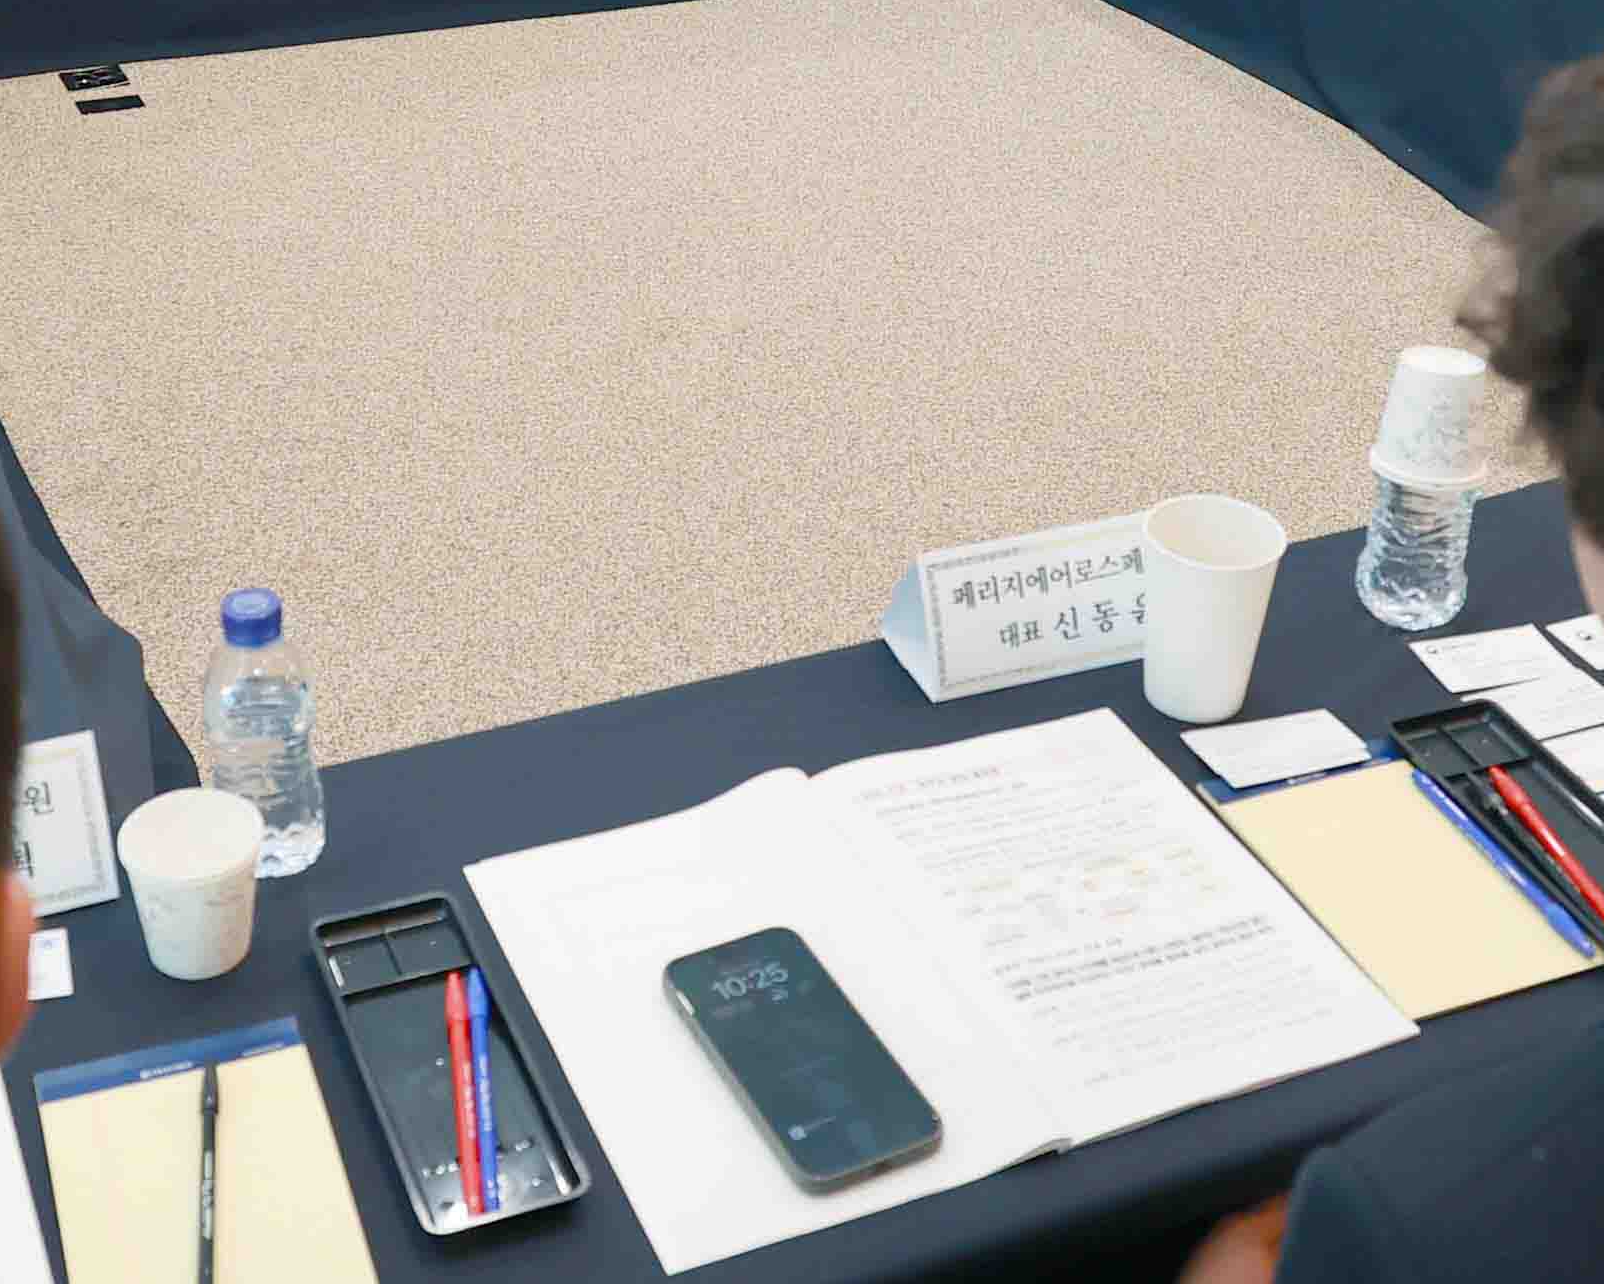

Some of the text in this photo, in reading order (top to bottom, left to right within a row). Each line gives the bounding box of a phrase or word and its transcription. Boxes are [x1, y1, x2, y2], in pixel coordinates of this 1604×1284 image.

[952, 547, 1145, 608] 페리지에어로스페
[999, 620, 1044, 648] 대표
[711, 962, 789, 1001] 10:25
